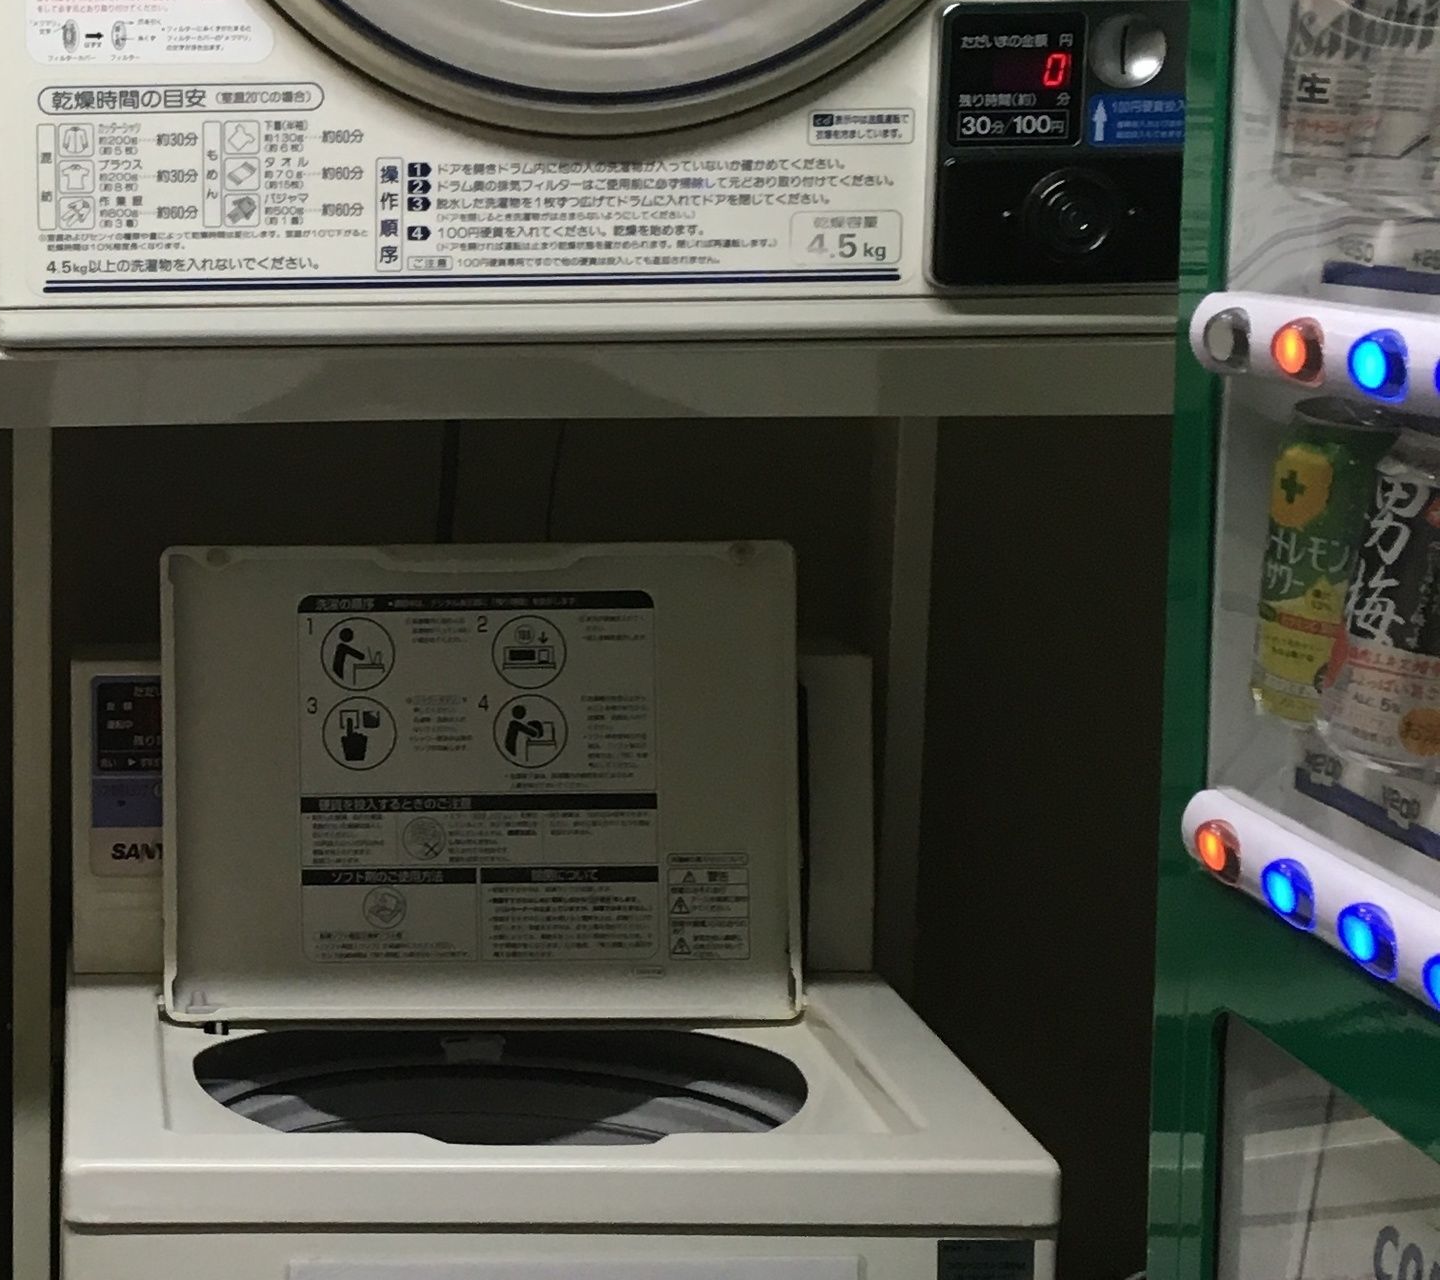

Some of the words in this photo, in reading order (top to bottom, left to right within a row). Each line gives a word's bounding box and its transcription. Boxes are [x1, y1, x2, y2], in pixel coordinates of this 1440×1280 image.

[1059, 34, 1073, 48] 円
[1043, 53, 1067, 86] 0
[1296, 72, 1331, 105] 生
[52, 89, 206, 110] 乾燥時間の目安
[1057, 94, 1071, 106] 分
[156, 133, 198, 146] 約30分
[99, 159, 143, 170] ブラウス
[157, 169, 198, 183] 約30分
[380, 165, 399, 264] 操作順序
[864, 243, 886, 260] kg
[46, 257, 320, 276] 4.5kg以上の洗濯物を入れないでください。
[477, 616, 488, 632] 2
[307, 697, 318, 713] 3
[478, 695, 489, 711] 4
